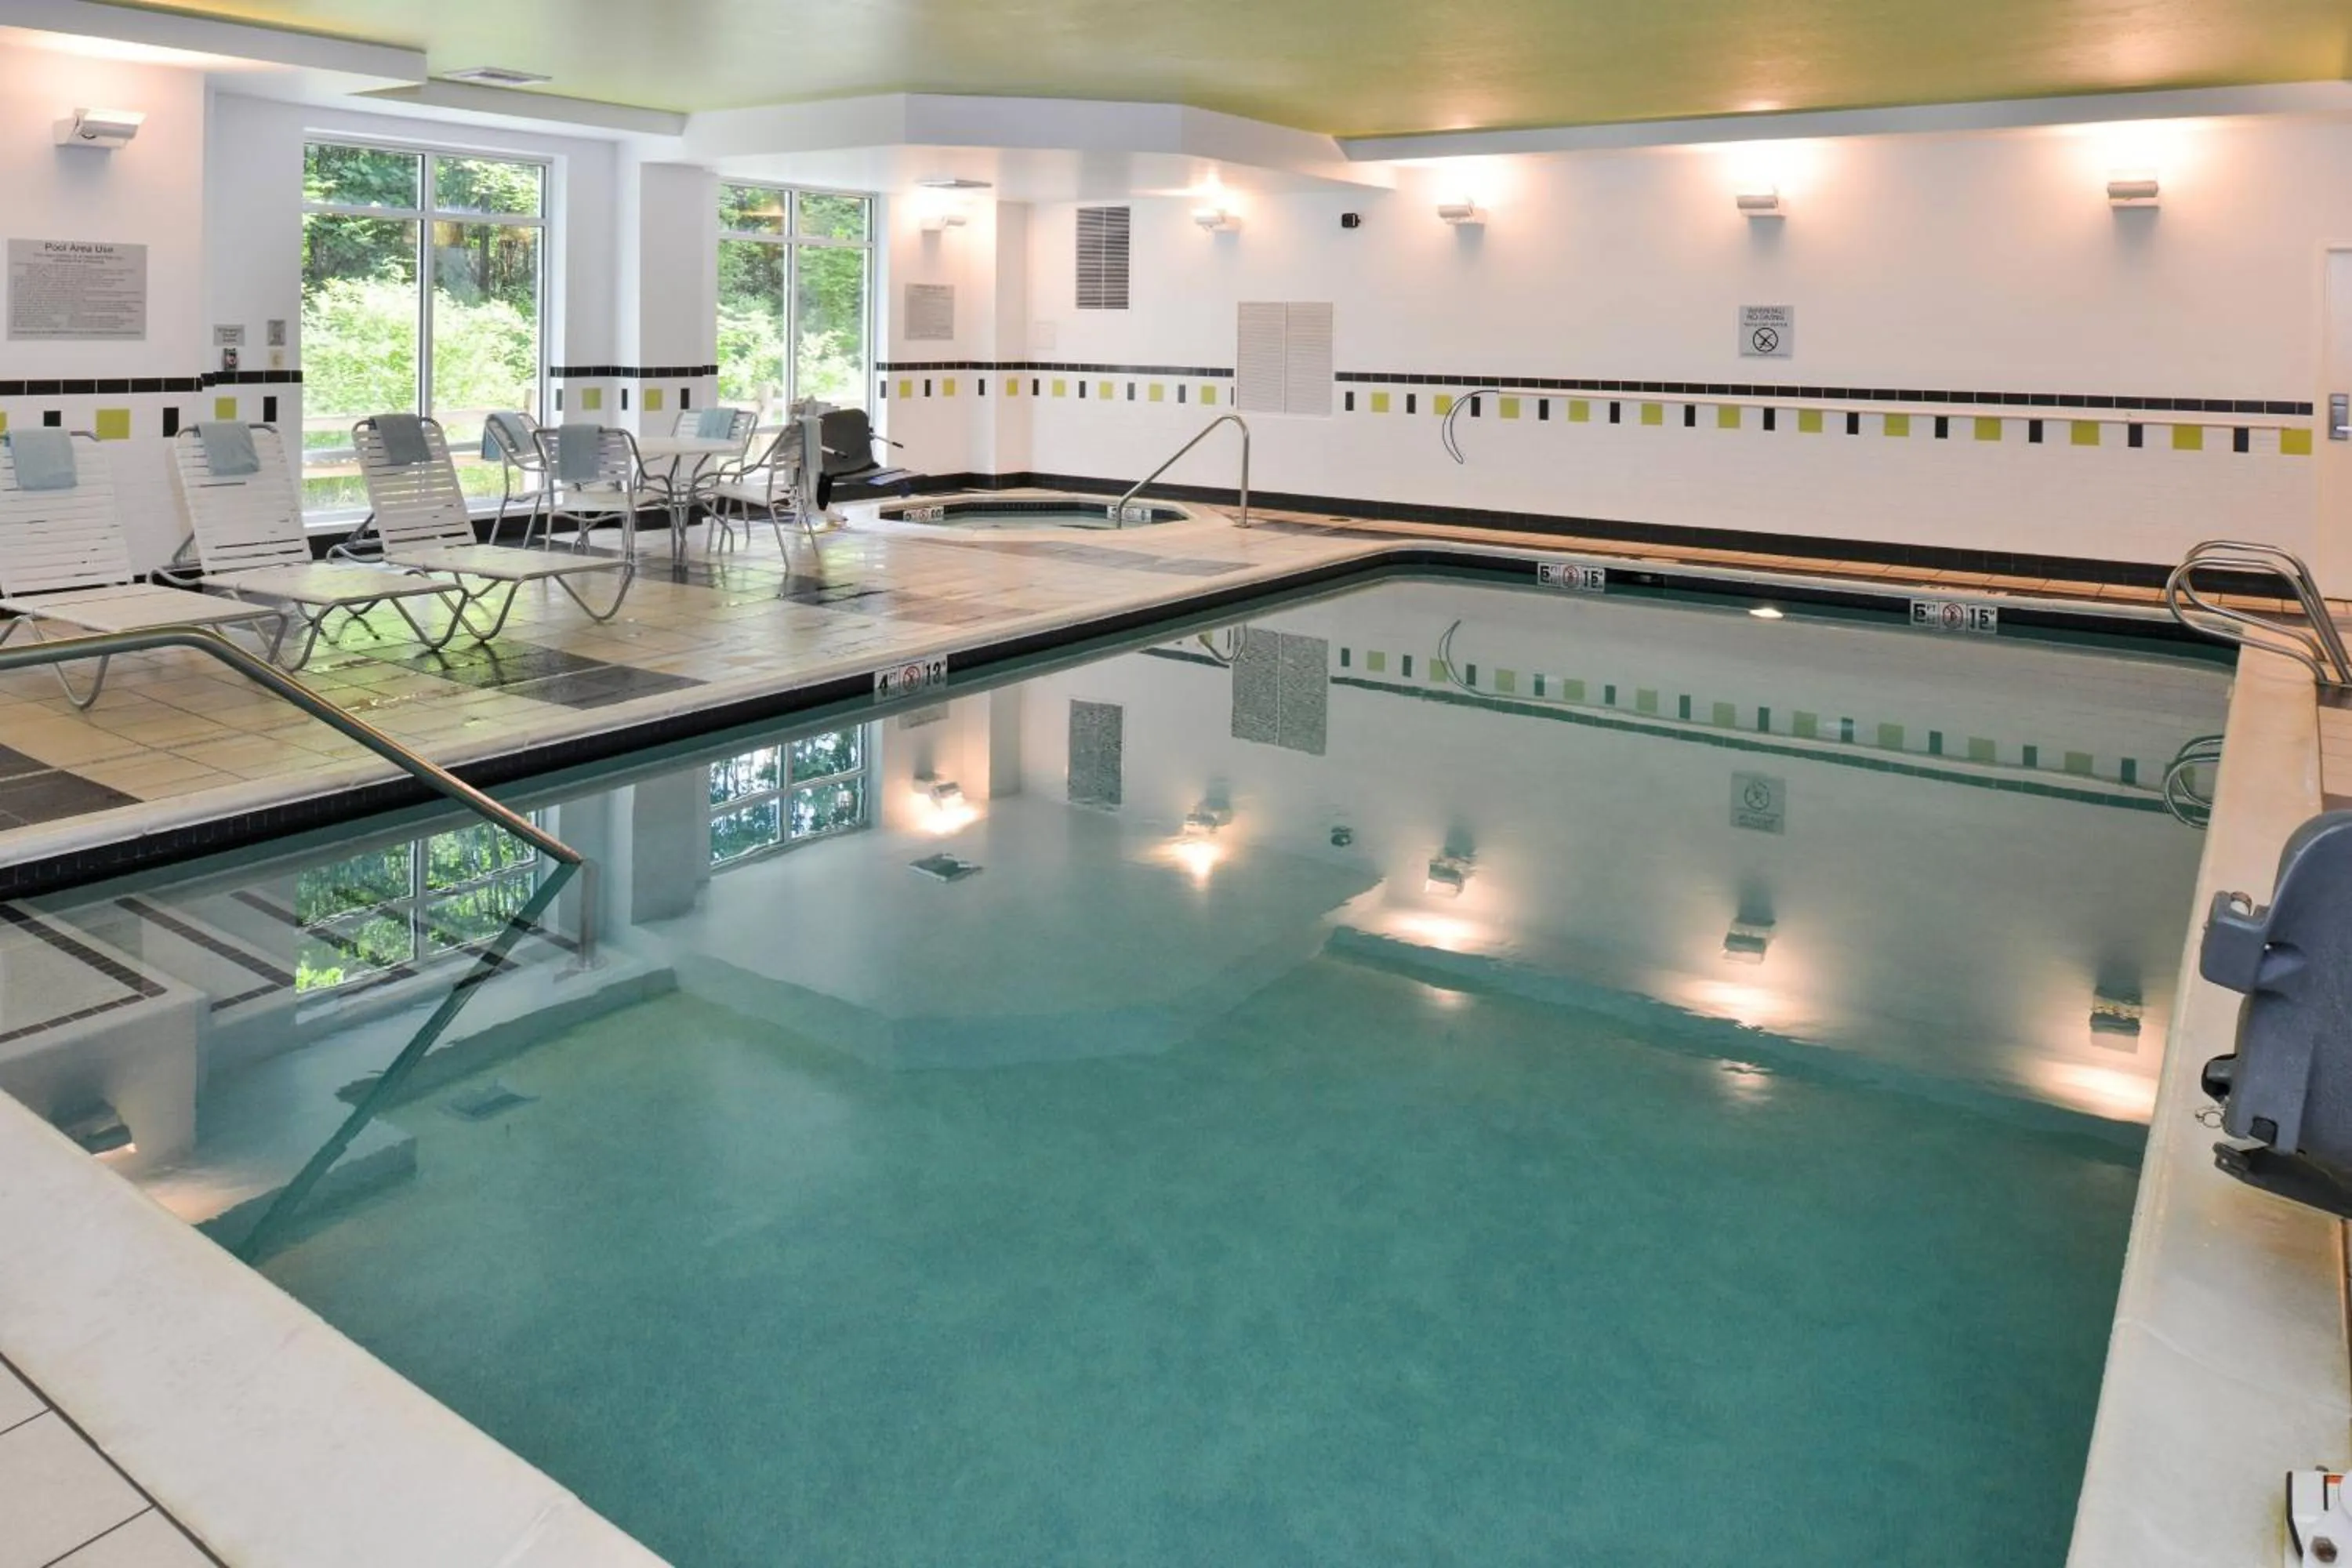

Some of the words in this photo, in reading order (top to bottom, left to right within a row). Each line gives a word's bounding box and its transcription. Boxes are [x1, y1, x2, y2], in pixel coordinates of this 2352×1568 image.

[45, 242, 67, 252] Pool
[69, 243, 93, 253] Area
[95, 245, 114, 253] Use
[879, 673, 888, 689] 4
